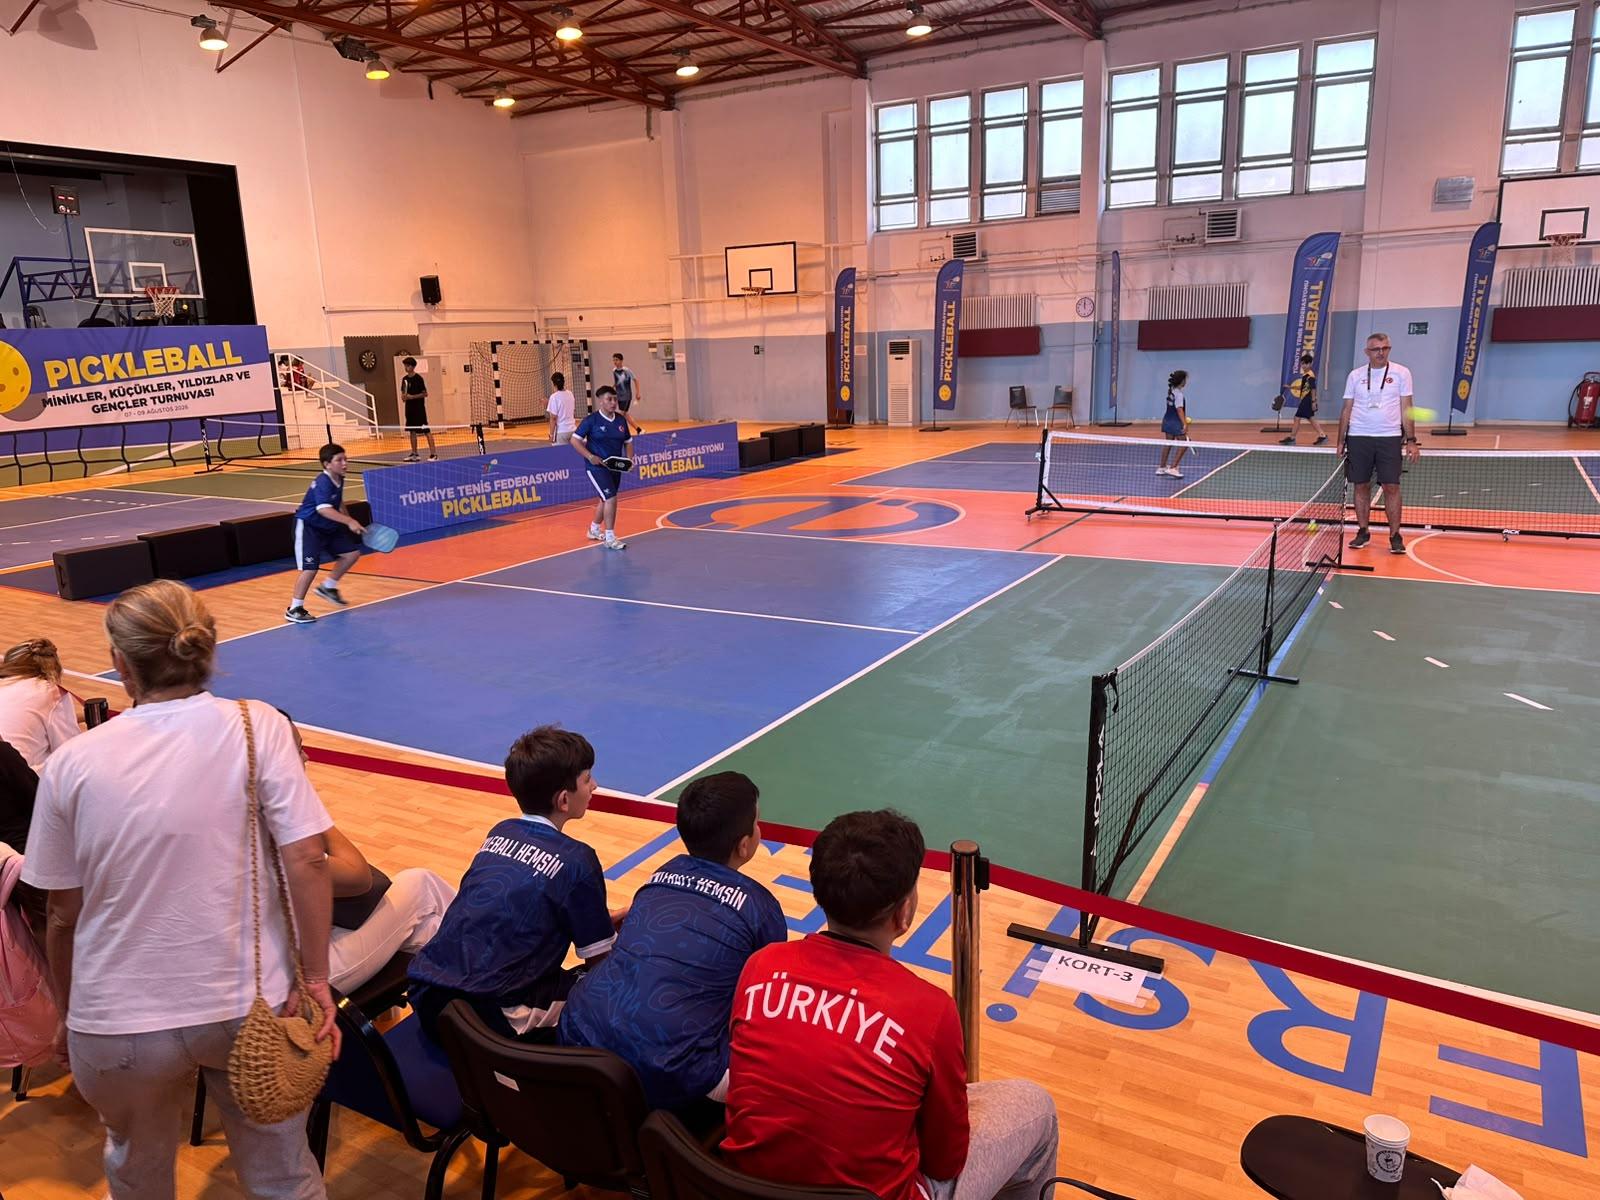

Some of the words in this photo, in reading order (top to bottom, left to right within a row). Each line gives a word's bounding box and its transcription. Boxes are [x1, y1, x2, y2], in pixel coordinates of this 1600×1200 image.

[843, 306, 851, 383] PICKLEBALL
[944, 301, 956, 381] PICKLEBALL
[44, 341, 242, 388] PICKLEBALL
[42, 391, 107, 408] MİNİKLER,
[109, 382, 176, 399] KÜÇÜKLER,
[178, 374, 235, 389] YILDIZLAR
[236, 370, 251, 381] VE
[91, 399, 148, 415] GENÇLER
[150, 388, 215, 406] TURNUVASI
[640, 455, 704, 480] PICKLEBALL
[649, 449, 672, 462] TENİS
[673, 442, 724, 459] FEDERASYONU
[400, 486, 455, 506] TÜRKİYE
[457, 479, 492, 496] TENİS
[494, 469, 570, 491] FEDERASYONU
[442, 486, 542, 518] PICKLEBALL
[513, 843, 564, 879] HEMŞİN
[695, 877, 747, 911] HEMŞİN
[1058, 955, 1134, 982] KORT-3
[744, 972, 905, 1065] TÜRKİYE
